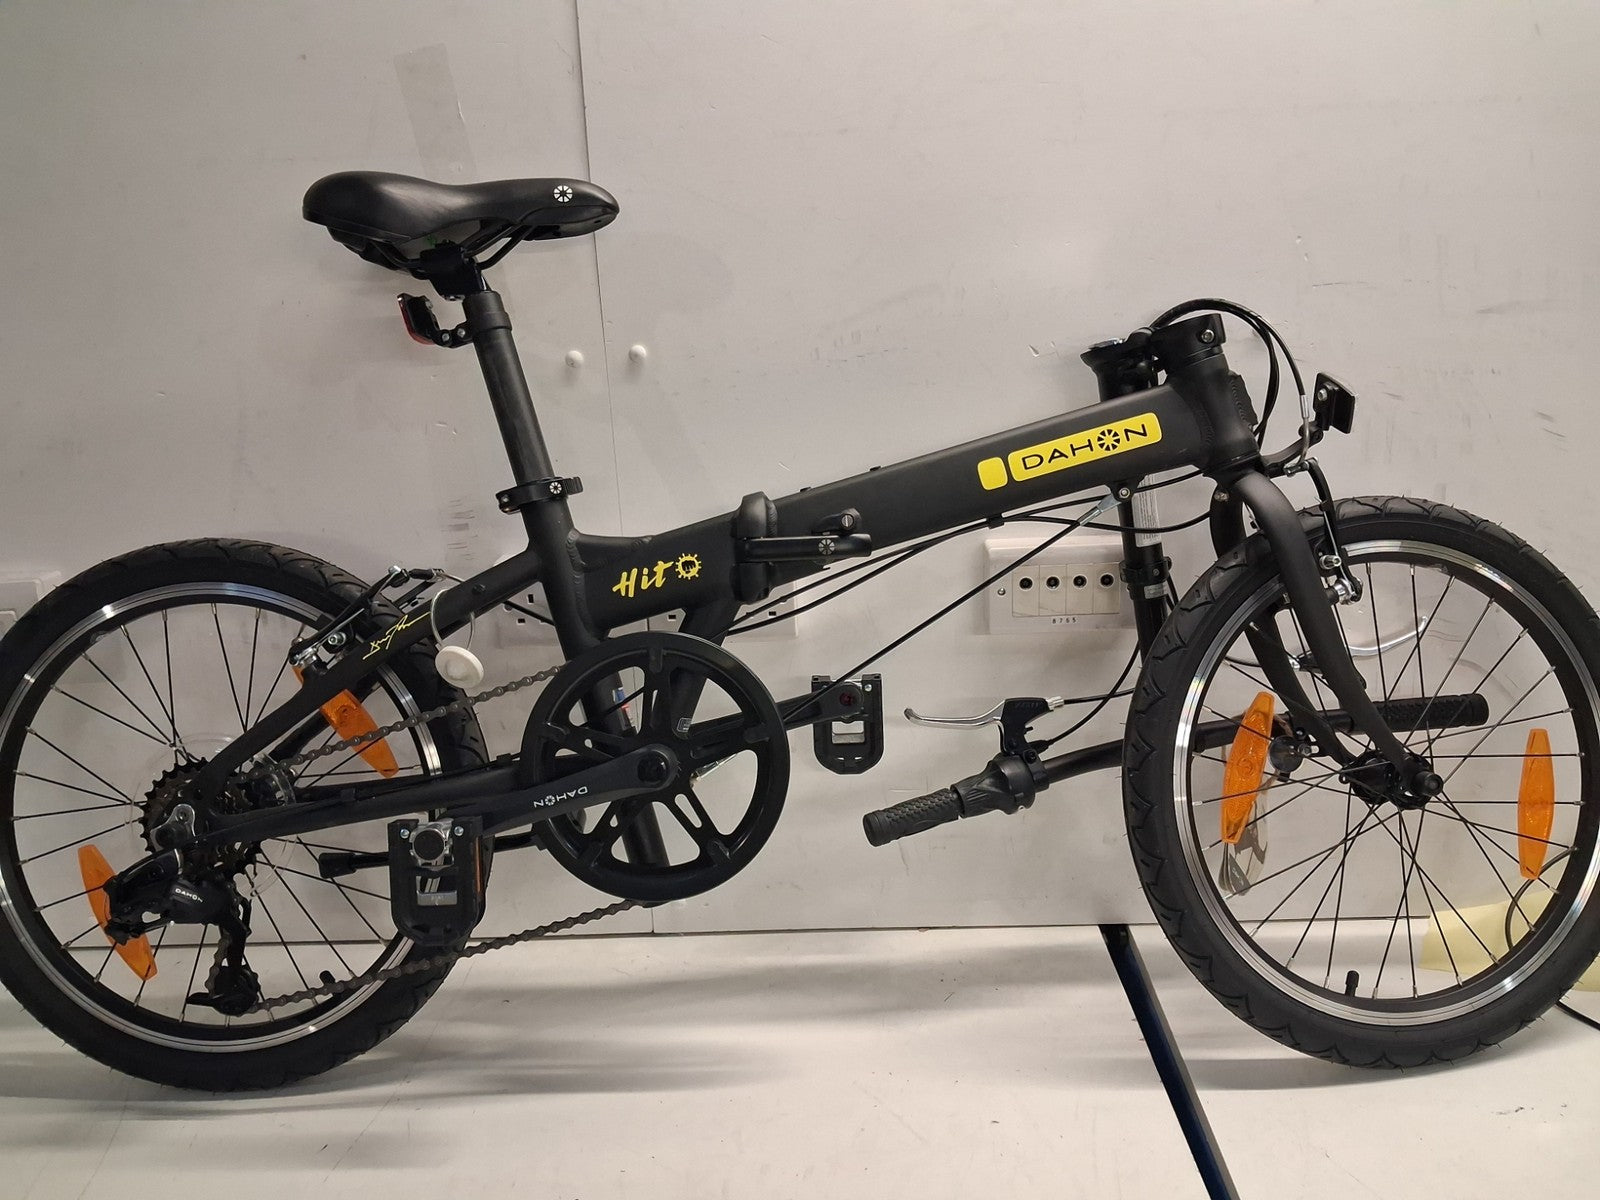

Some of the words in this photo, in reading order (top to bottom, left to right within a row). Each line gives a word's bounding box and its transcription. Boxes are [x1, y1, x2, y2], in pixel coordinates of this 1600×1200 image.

[1021, 423, 1148, 470] DAHON
[612, 560, 674, 598] Hit
[533, 786, 588, 808] DAHON
[175, 888, 203, 903] DAHON
